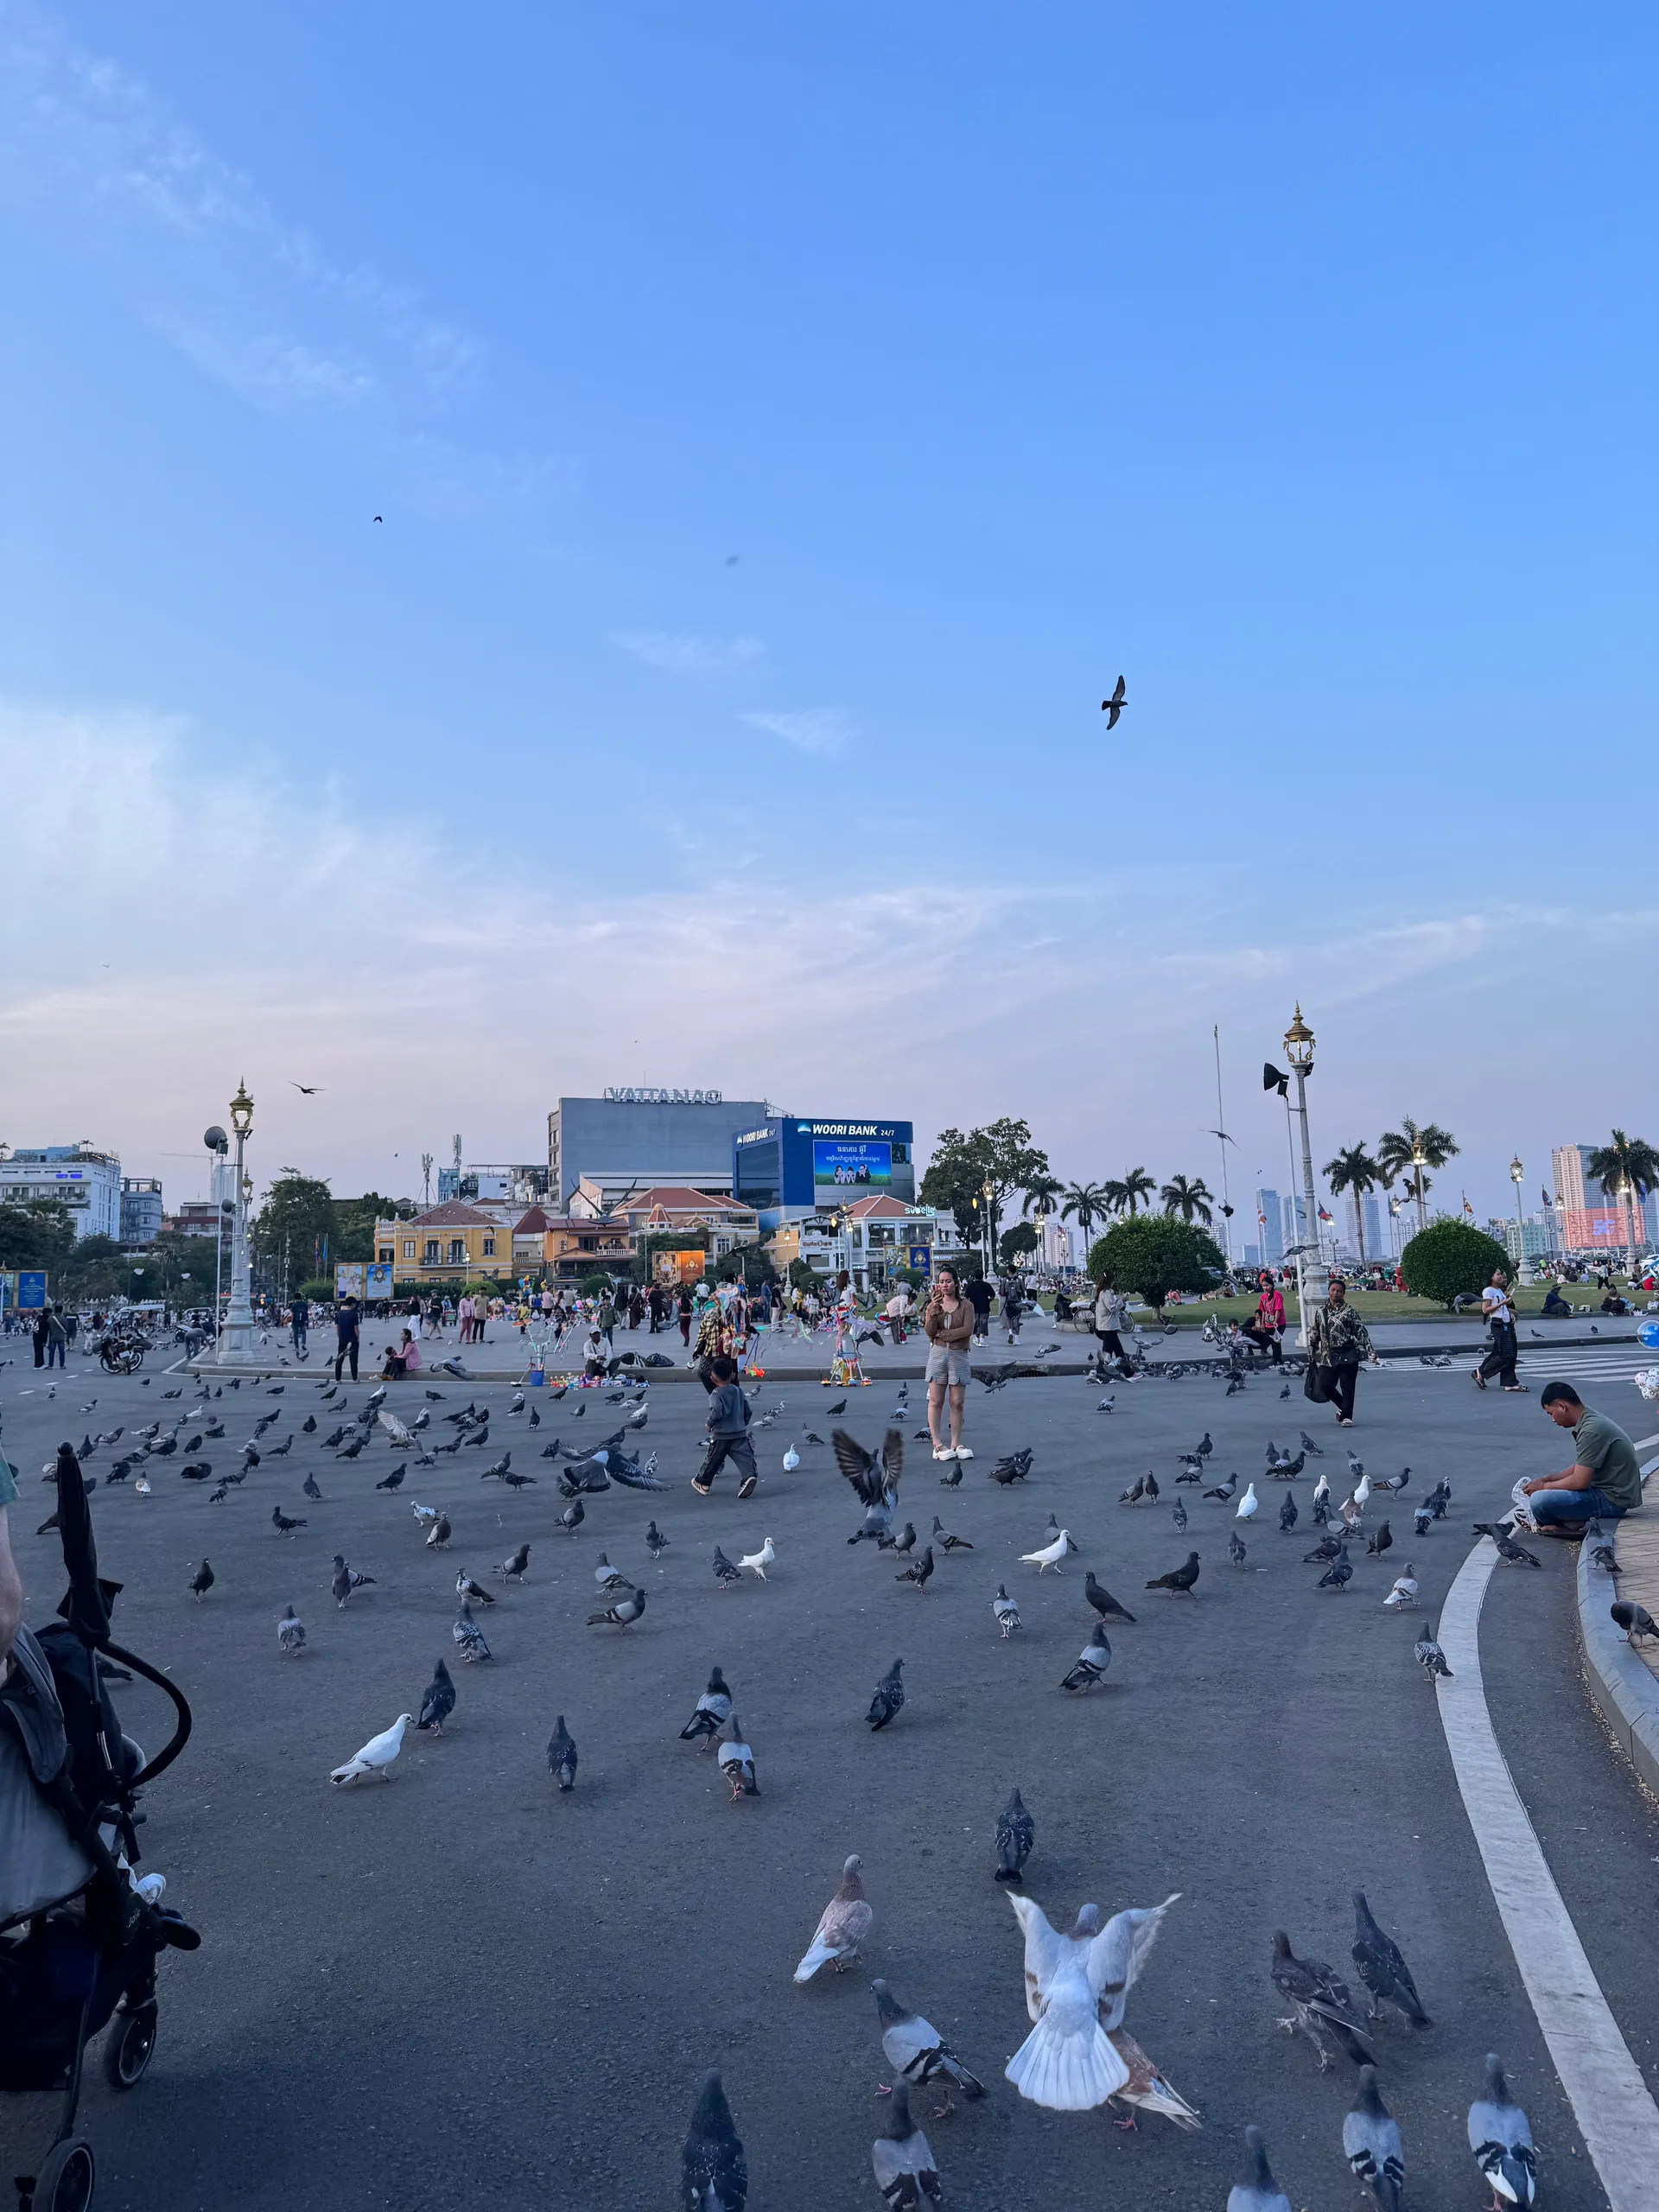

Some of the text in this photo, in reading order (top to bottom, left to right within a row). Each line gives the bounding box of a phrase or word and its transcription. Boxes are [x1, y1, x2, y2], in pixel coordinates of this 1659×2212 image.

[607, 1087, 720, 1104] VATTANAC
[812, 1124, 847, 1135] WOORI
[848, 1125, 878, 1136] BANK
[1592, 1219, 1615, 1236] 5G
